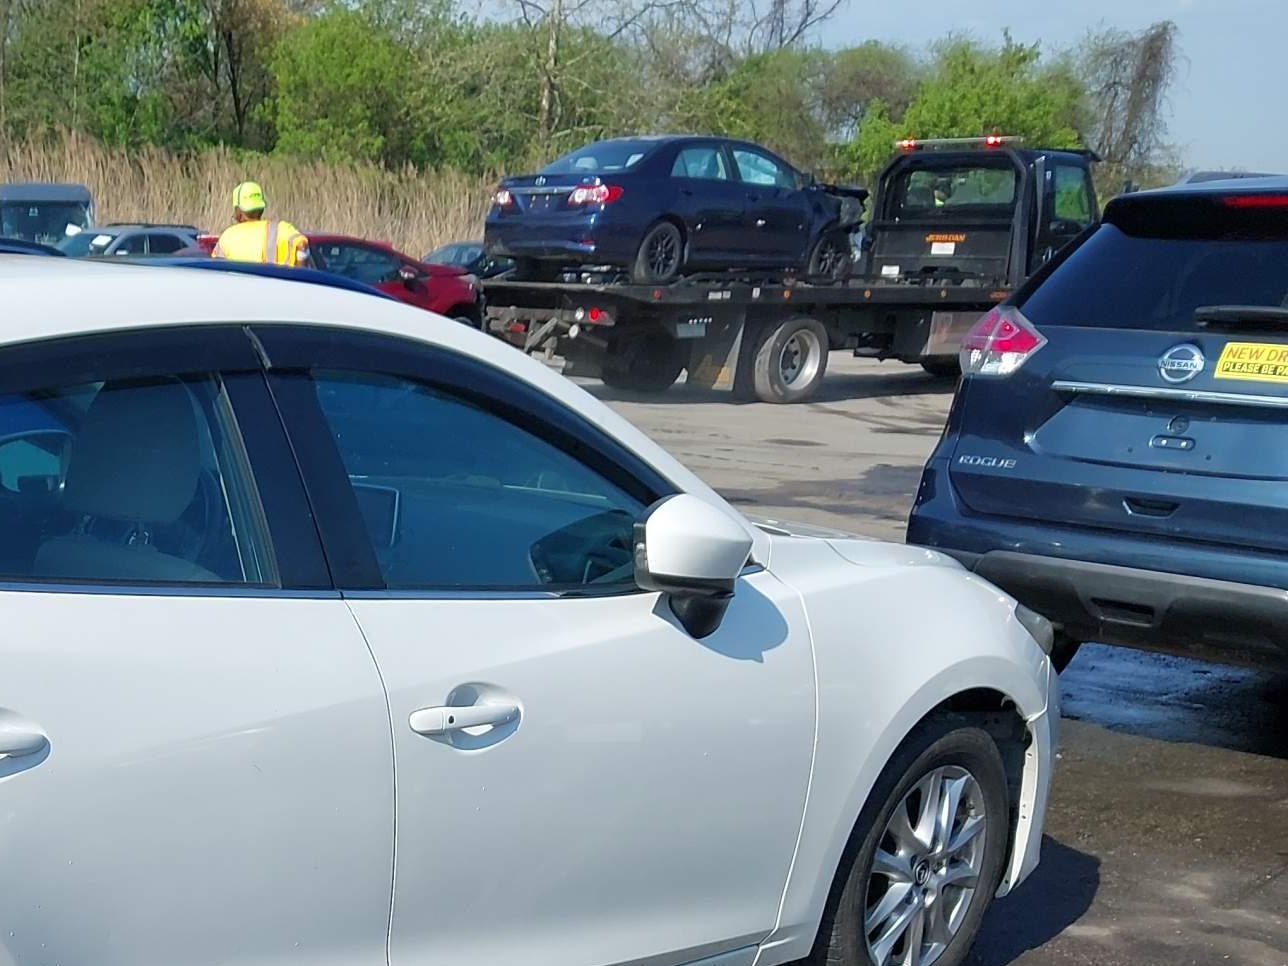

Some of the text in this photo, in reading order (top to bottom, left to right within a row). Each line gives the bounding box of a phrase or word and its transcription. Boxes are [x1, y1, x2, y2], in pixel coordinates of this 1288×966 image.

[1226, 346, 1265, 360] NEW
[1160, 361, 1198, 369] NISSAN
[1222, 361, 1260, 373] PLEASE
[1261, 364, 1276, 375] BE
[958, 455, 1017, 469] ROGUE
